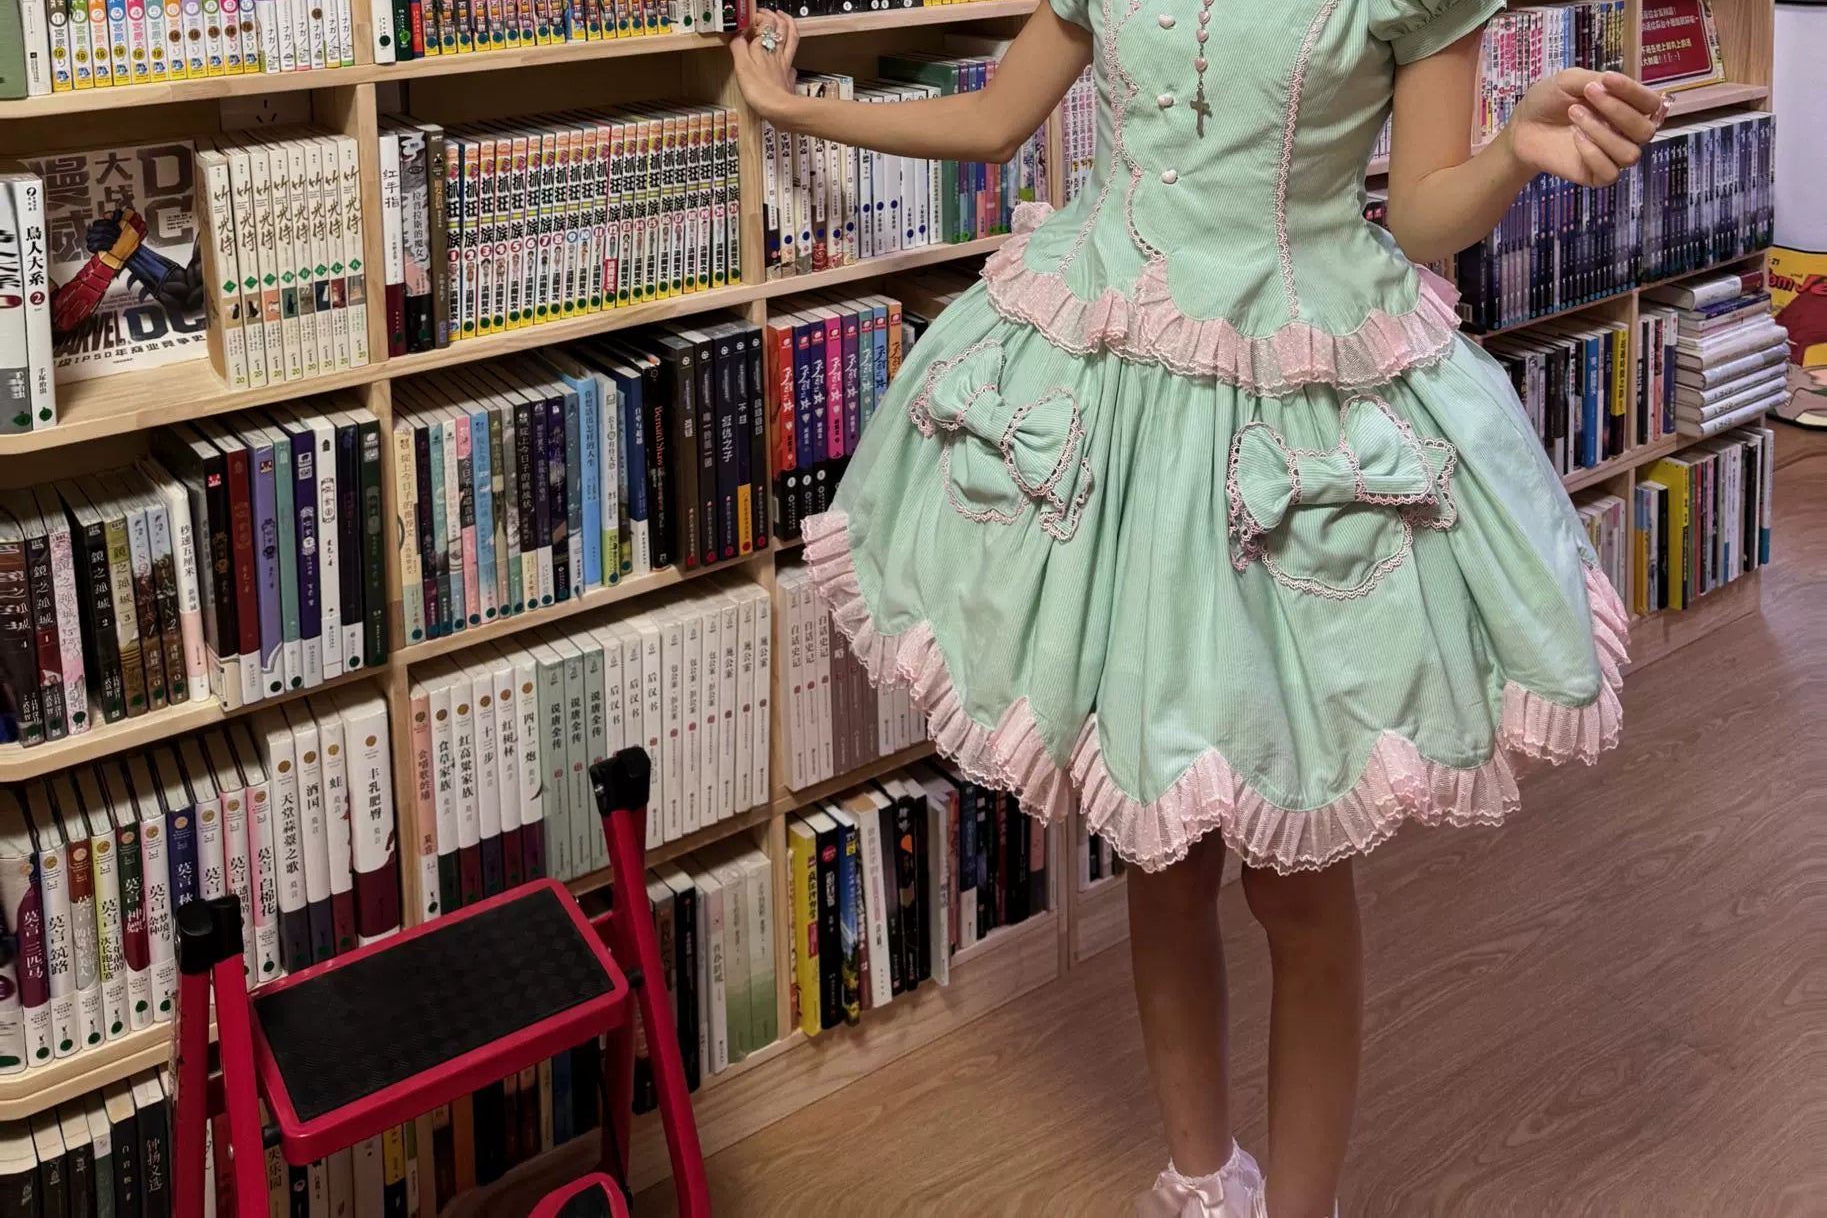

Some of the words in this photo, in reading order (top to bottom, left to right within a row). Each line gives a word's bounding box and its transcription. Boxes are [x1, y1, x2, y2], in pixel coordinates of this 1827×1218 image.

[267, 29, 277, 55] ナガノ
[282, 26, 293, 52] ナガノ
[382, 168, 399, 210] 红手指
[554, 167, 566, 231] 抓狂一族
[609, 159, 620, 222] 抓狂一族
[715, 146, 726, 207] 抓狂一族
[727, 144, 738, 207] 抓狂一族
[29, 155, 88, 264] 漫威
[95, 152, 135, 215] 大战
[137, 145, 194, 246] DC
[464, 181, 478, 248] 抓狂一族
[480, 177, 494, 242] 抓狂一族
[512, 171, 524, 238] 抓狂一族
[541, 168, 554, 233] 抓狂一族
[25, 226, 45, 286] 鳥人大系
[254, 370, 263, 378] 20
[180, 525, 196, 579] 秒速五厘米
[91, 550, 111, 609] 鏡之孤城
[610, 684, 621, 726] 后汉书
[648, 672, 658, 712] 后汉书
[502, 719, 518, 759] 红树林
[523, 712, 537, 763] 四十一炮
[551, 703, 562, 751] 说唐全传
[570, 697, 582, 744] 说唐全传
[439, 740, 452, 792] 食草家族
[458, 734, 474, 799] 红高粱家族
[483, 727, 493, 765] 十三步
[306, 783, 320, 810] 酒国
[328, 776, 344, 789] 蛙
[367, 768, 382, 820] 丰乳肥臀
[281, 791, 299, 875] 天堂蒜薹之歌
[258, 846, 273, 876] 莫言
[259, 878, 276, 916] 白棉花
[24, 911, 40, 938] 莫言
[49, 914, 66, 947] 莫言
[26, 943, 45, 981] 三匹马
[49, 949, 69, 976] 筑路
